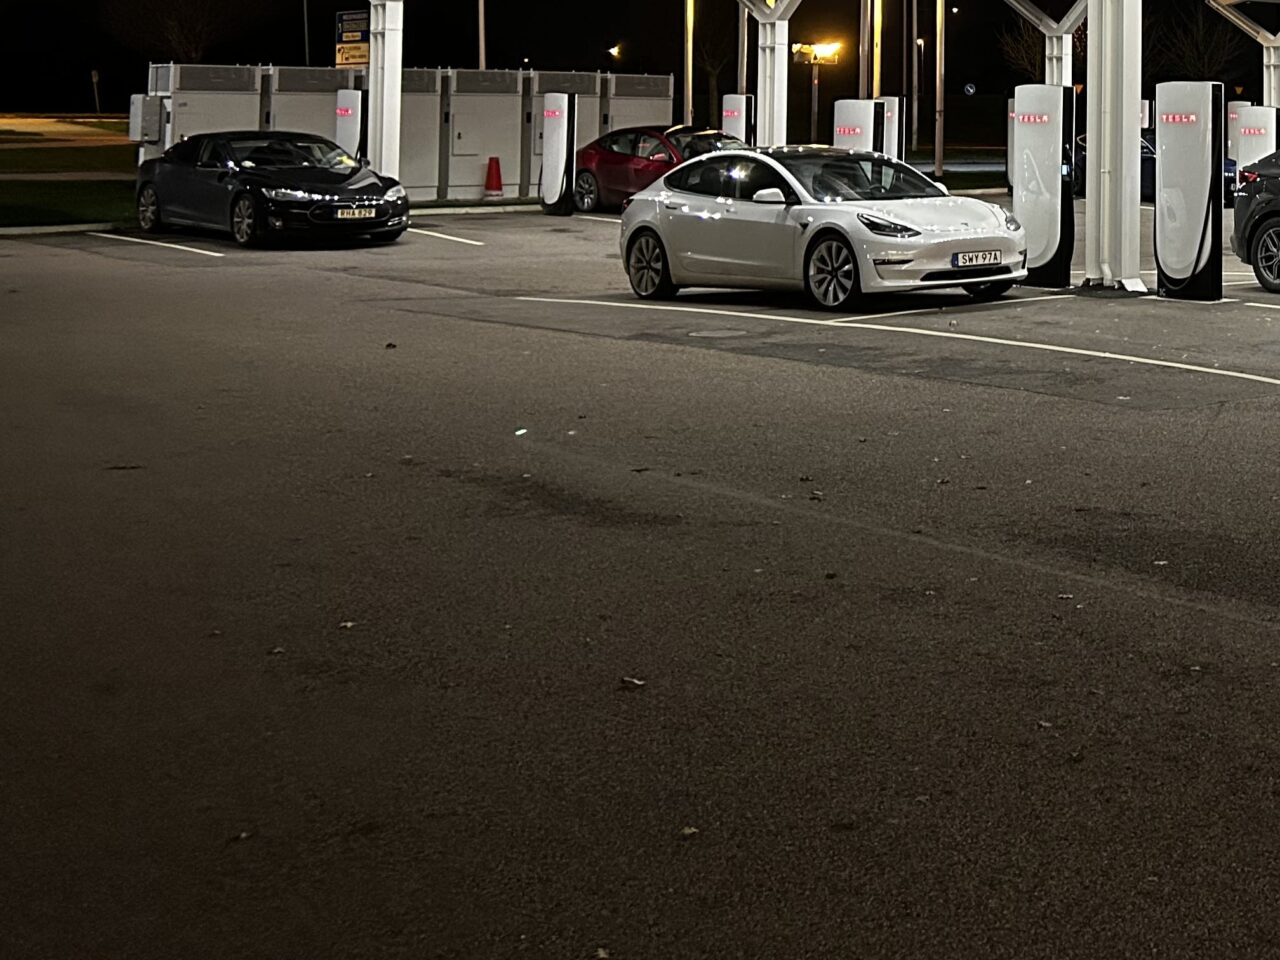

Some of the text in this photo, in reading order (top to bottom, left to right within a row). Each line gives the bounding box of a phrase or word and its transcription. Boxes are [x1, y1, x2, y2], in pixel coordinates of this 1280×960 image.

[1019, 115, 1049, 123] TESLA
[1162, 114, 1196, 123] TESLA
[962, 252, 998, 265] SWY 97A
